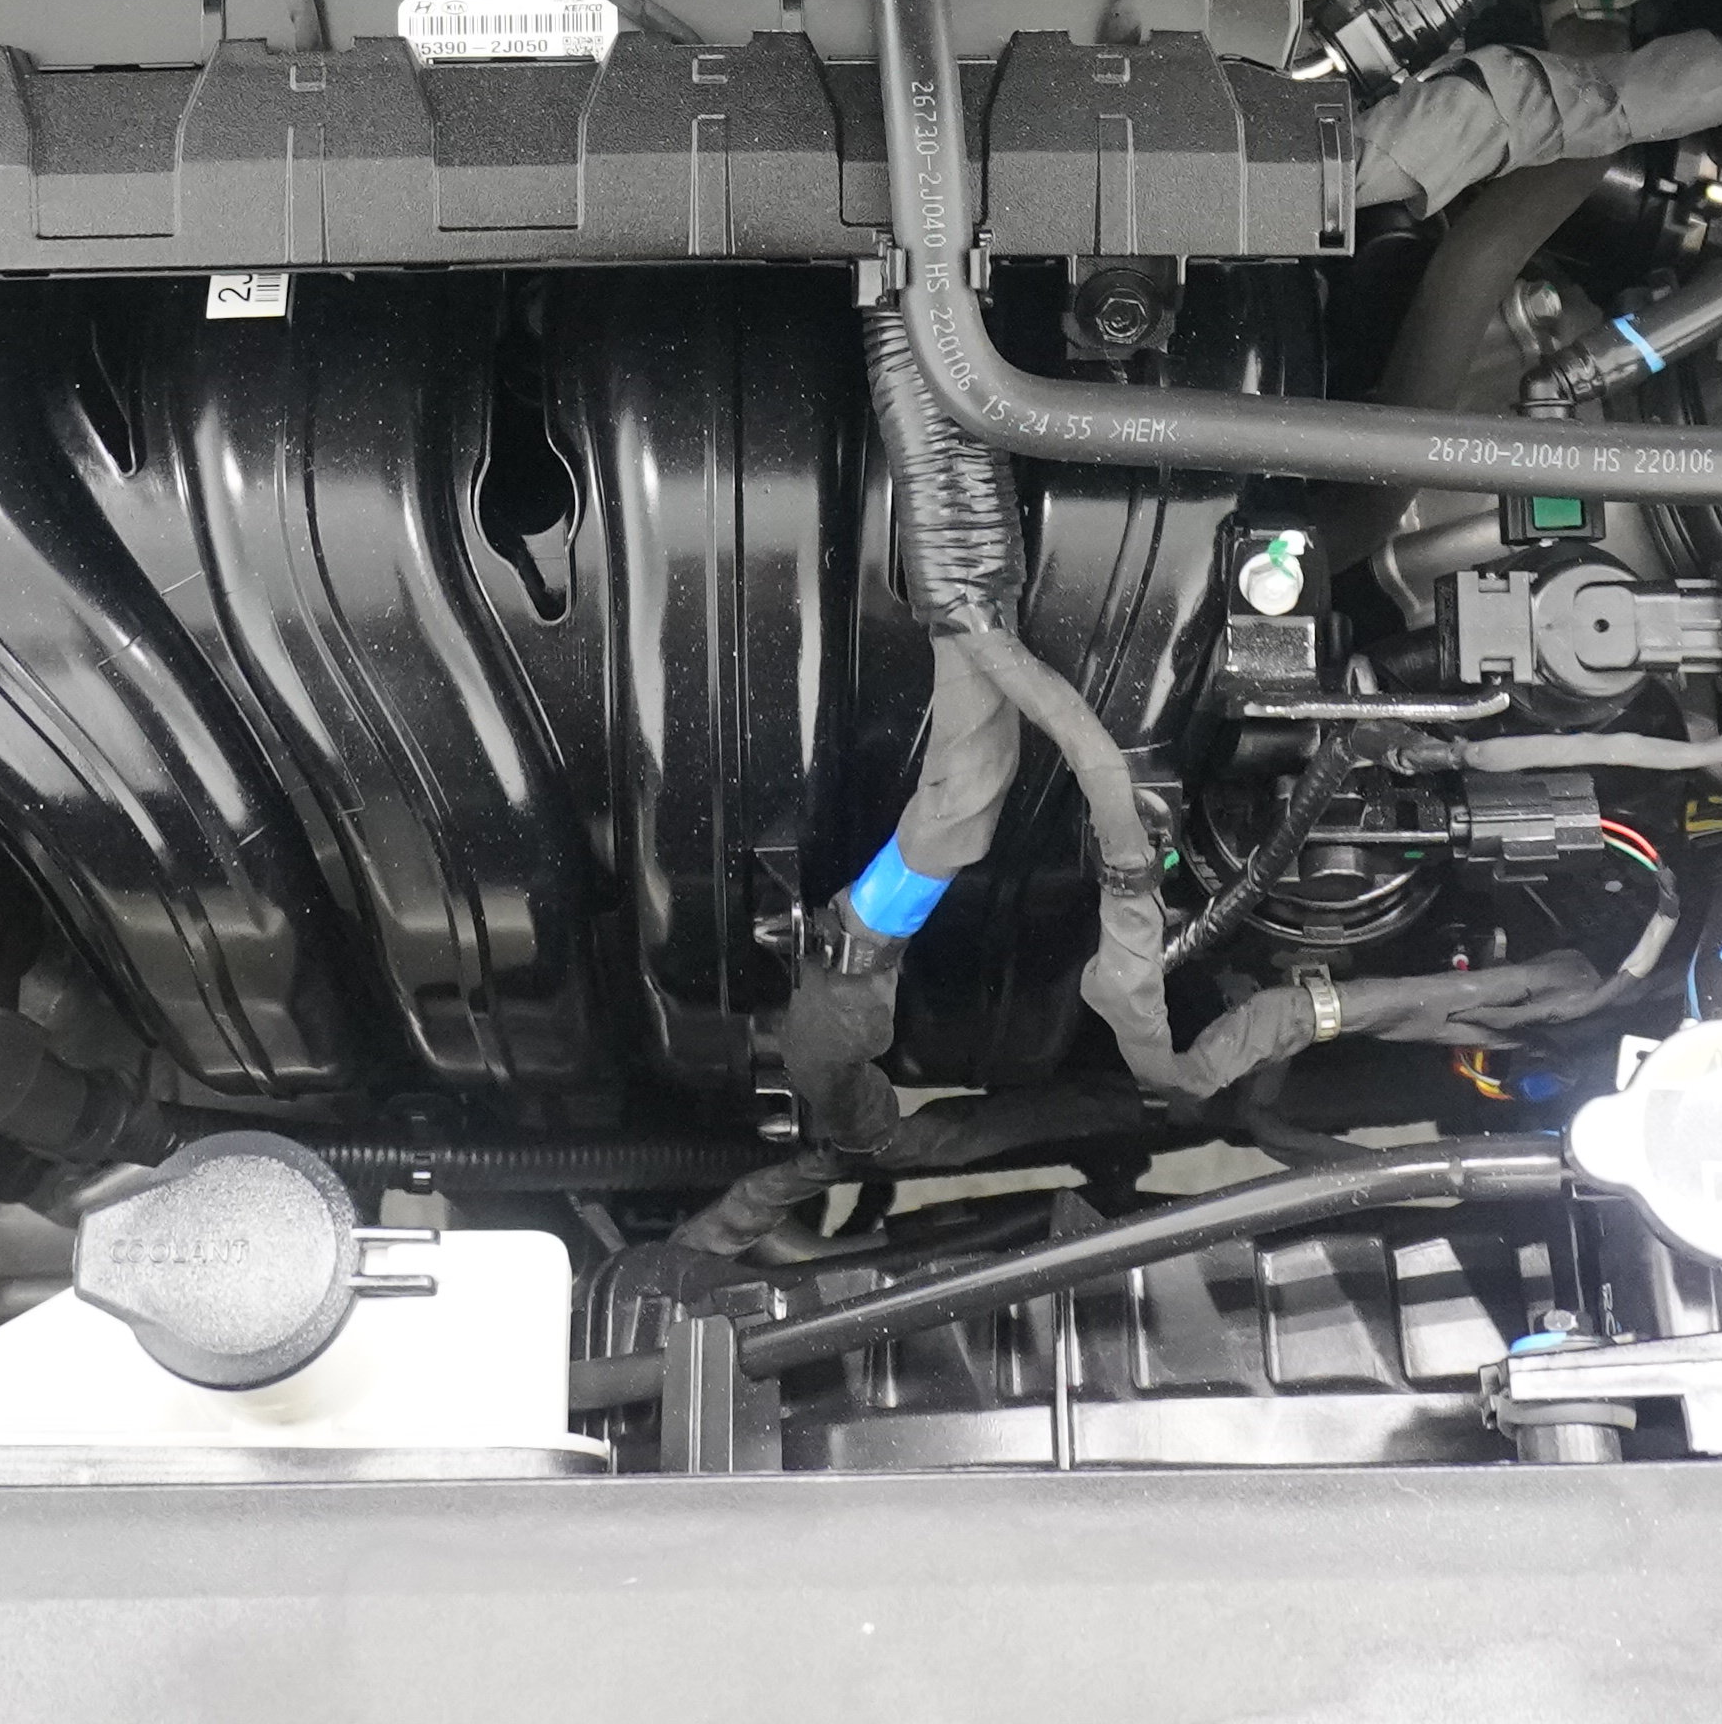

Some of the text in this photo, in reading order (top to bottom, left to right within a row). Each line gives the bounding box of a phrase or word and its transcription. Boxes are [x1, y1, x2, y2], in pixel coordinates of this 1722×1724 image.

[911, 80, 946, 248] 26730-2J040
[924, 262, 950, 293] HS
[929, 307, 978, 391] 220106
[1428, 436, 1580, 470] 26730-2J040
[1593, 446, 1621, 472] HS
[1634, 448, 1714, 474] 220106
[109, 1238, 250, 1264] COOLANT
